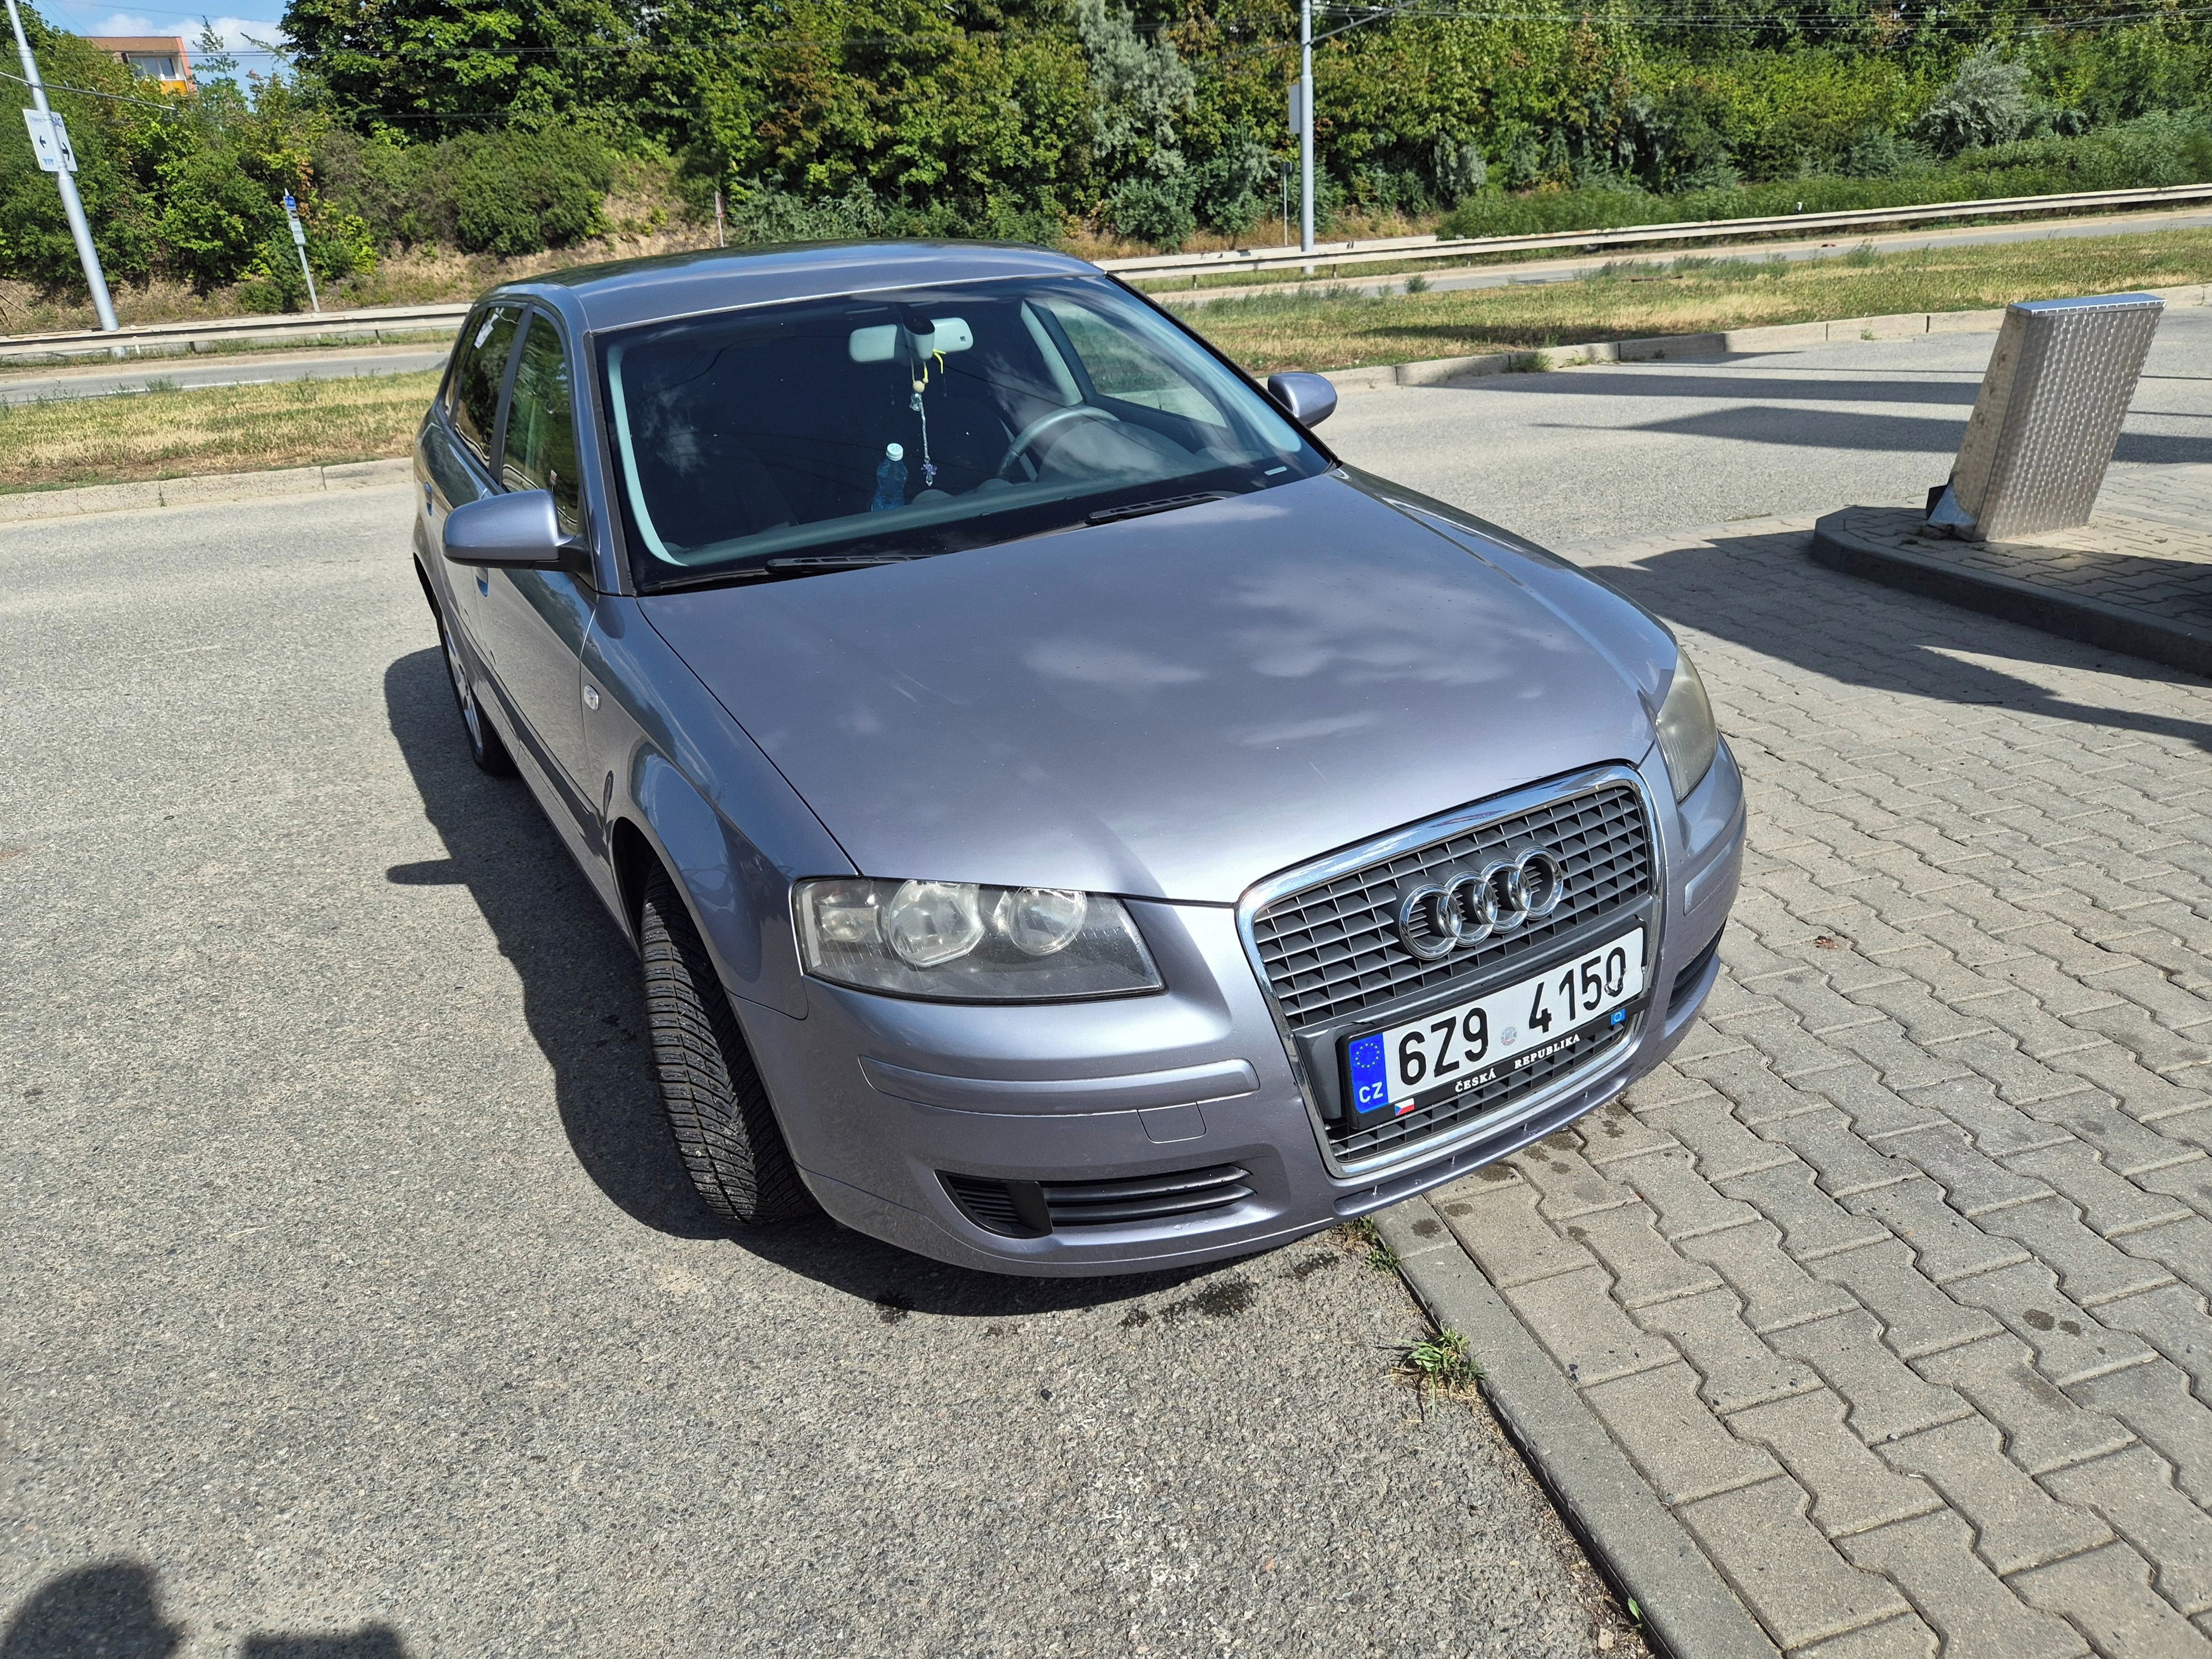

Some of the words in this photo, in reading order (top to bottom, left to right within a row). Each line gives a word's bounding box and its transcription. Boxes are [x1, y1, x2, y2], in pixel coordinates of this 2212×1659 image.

[1399, 1007, 1489, 1086] 6Z9
[1528, 946, 1626, 1033] 4150
[1359, 1082, 1384, 1104] CZ
[1455, 1067, 1496, 1093] ČESKÁ
[1514, 1033, 1581, 1068] REPUBLIKA
